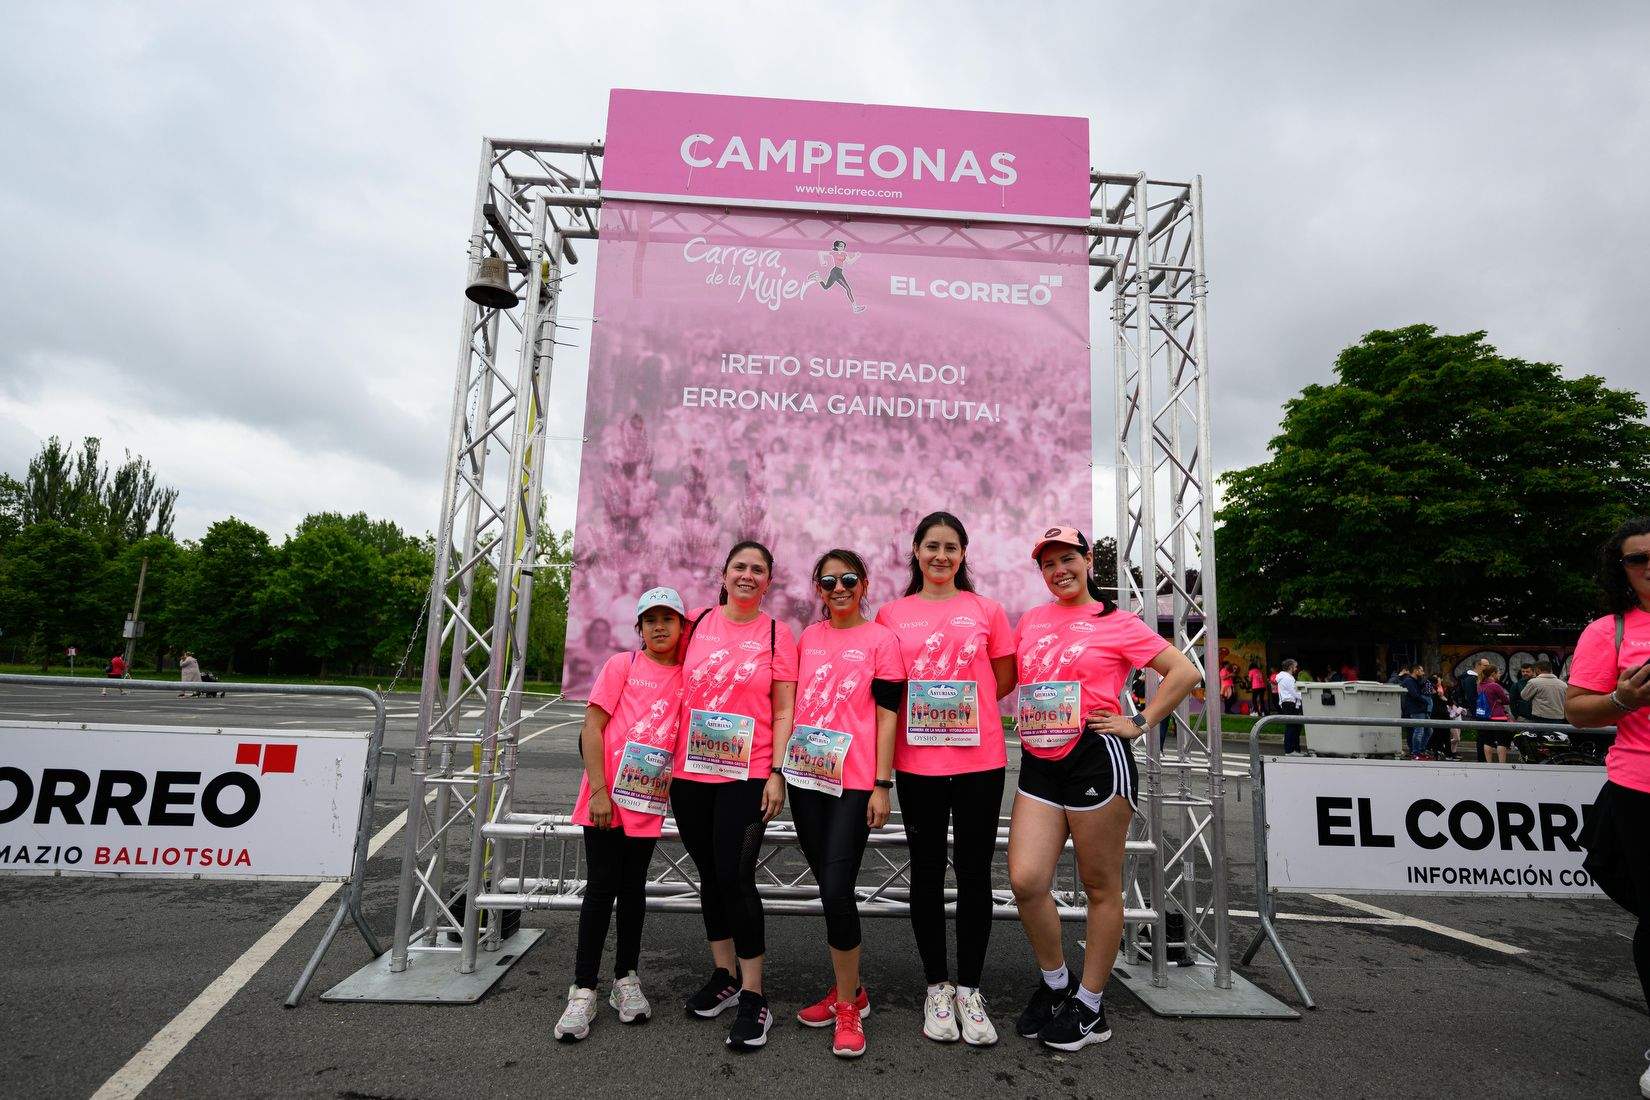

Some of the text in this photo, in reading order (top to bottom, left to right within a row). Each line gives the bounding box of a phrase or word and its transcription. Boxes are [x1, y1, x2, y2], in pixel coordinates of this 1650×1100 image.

[680, 133, 1018, 186] CAMPEONAS
[795, 184, 903, 199] www.elcorreo.com
[683, 237, 782, 269] Carrera
[705, 265, 817, 311] de la Mujer
[890, 275, 1053, 306] EL CORREO
[720, 353, 966, 386] ¡RETO SUPERADO!
[682, 386, 1001, 424] ERRONKA GAINDITUTA!
[629, 678, 658, 689] OYSHO
[930, 709, 957, 720] 016
[1035, 711, 1057, 721] 016
[707, 739, 730, 752] 016
[804, 754, 824, 767] 016
[640, 775, 661, 787] 016
[618, 797, 641, 807] OYSHO
[1315, 796, 1594, 852] EL CORR
[94, 846, 252, 867] BALIOTSUA
[1407, 863, 1553, 887] INFORMACIÓN
